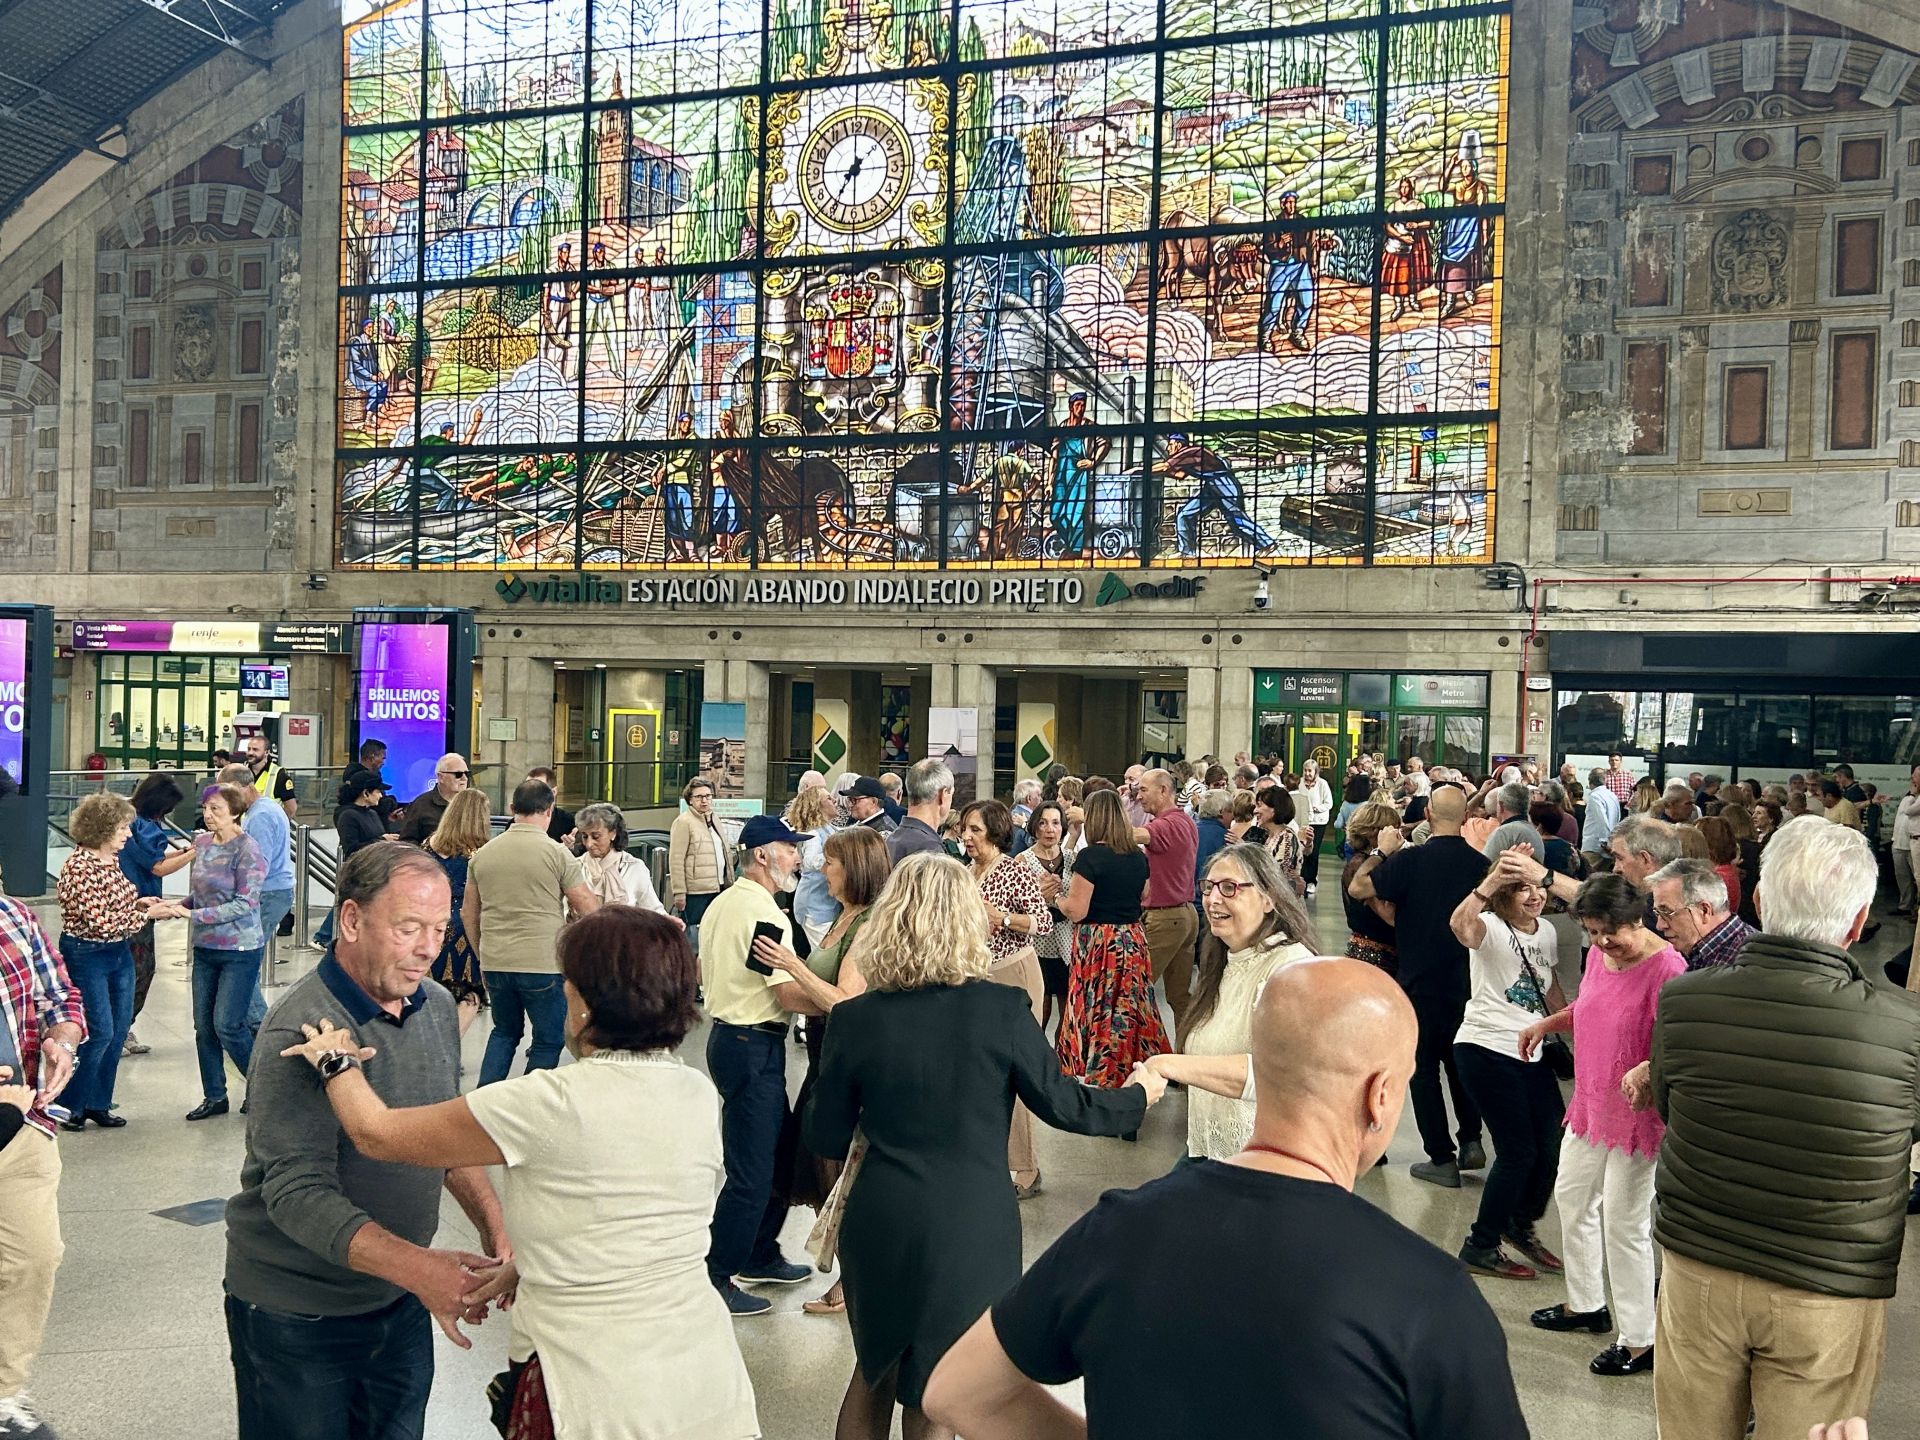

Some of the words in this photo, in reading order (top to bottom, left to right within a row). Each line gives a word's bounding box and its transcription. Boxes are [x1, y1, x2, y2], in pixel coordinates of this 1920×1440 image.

[851, 121, 863, 133] 12
[873, 125, 879, 137] 1
[831, 130, 840, 142] 11
[885, 139, 895, 151] 2
[816, 149, 827, 160] 10
[891, 160, 899, 172] 3
[812, 168, 820, 180] 9
[885, 182, 893, 194] 4
[817, 189, 825, 200] 8
[870, 201, 878, 213] 5
[850, 207, 858, 220] 6
[527, 572, 622, 602] vialia
[627, 573, 735, 603] ESTACIÓN
[743, 579, 846, 604] ABANDO
[853, 578, 981, 604] INDALECIO
[988, 577, 1082, 604] PRIETO
[1135, 575, 1208, 598] adif
[191, 626, 219, 640] renfe
[1300, 676, 1335, 684] Ascensor
[368, 688, 440, 702] BRILLEMOS
[1441, 689, 1465, 697] Metro
[367, 702, 440, 720] JUNTOS
